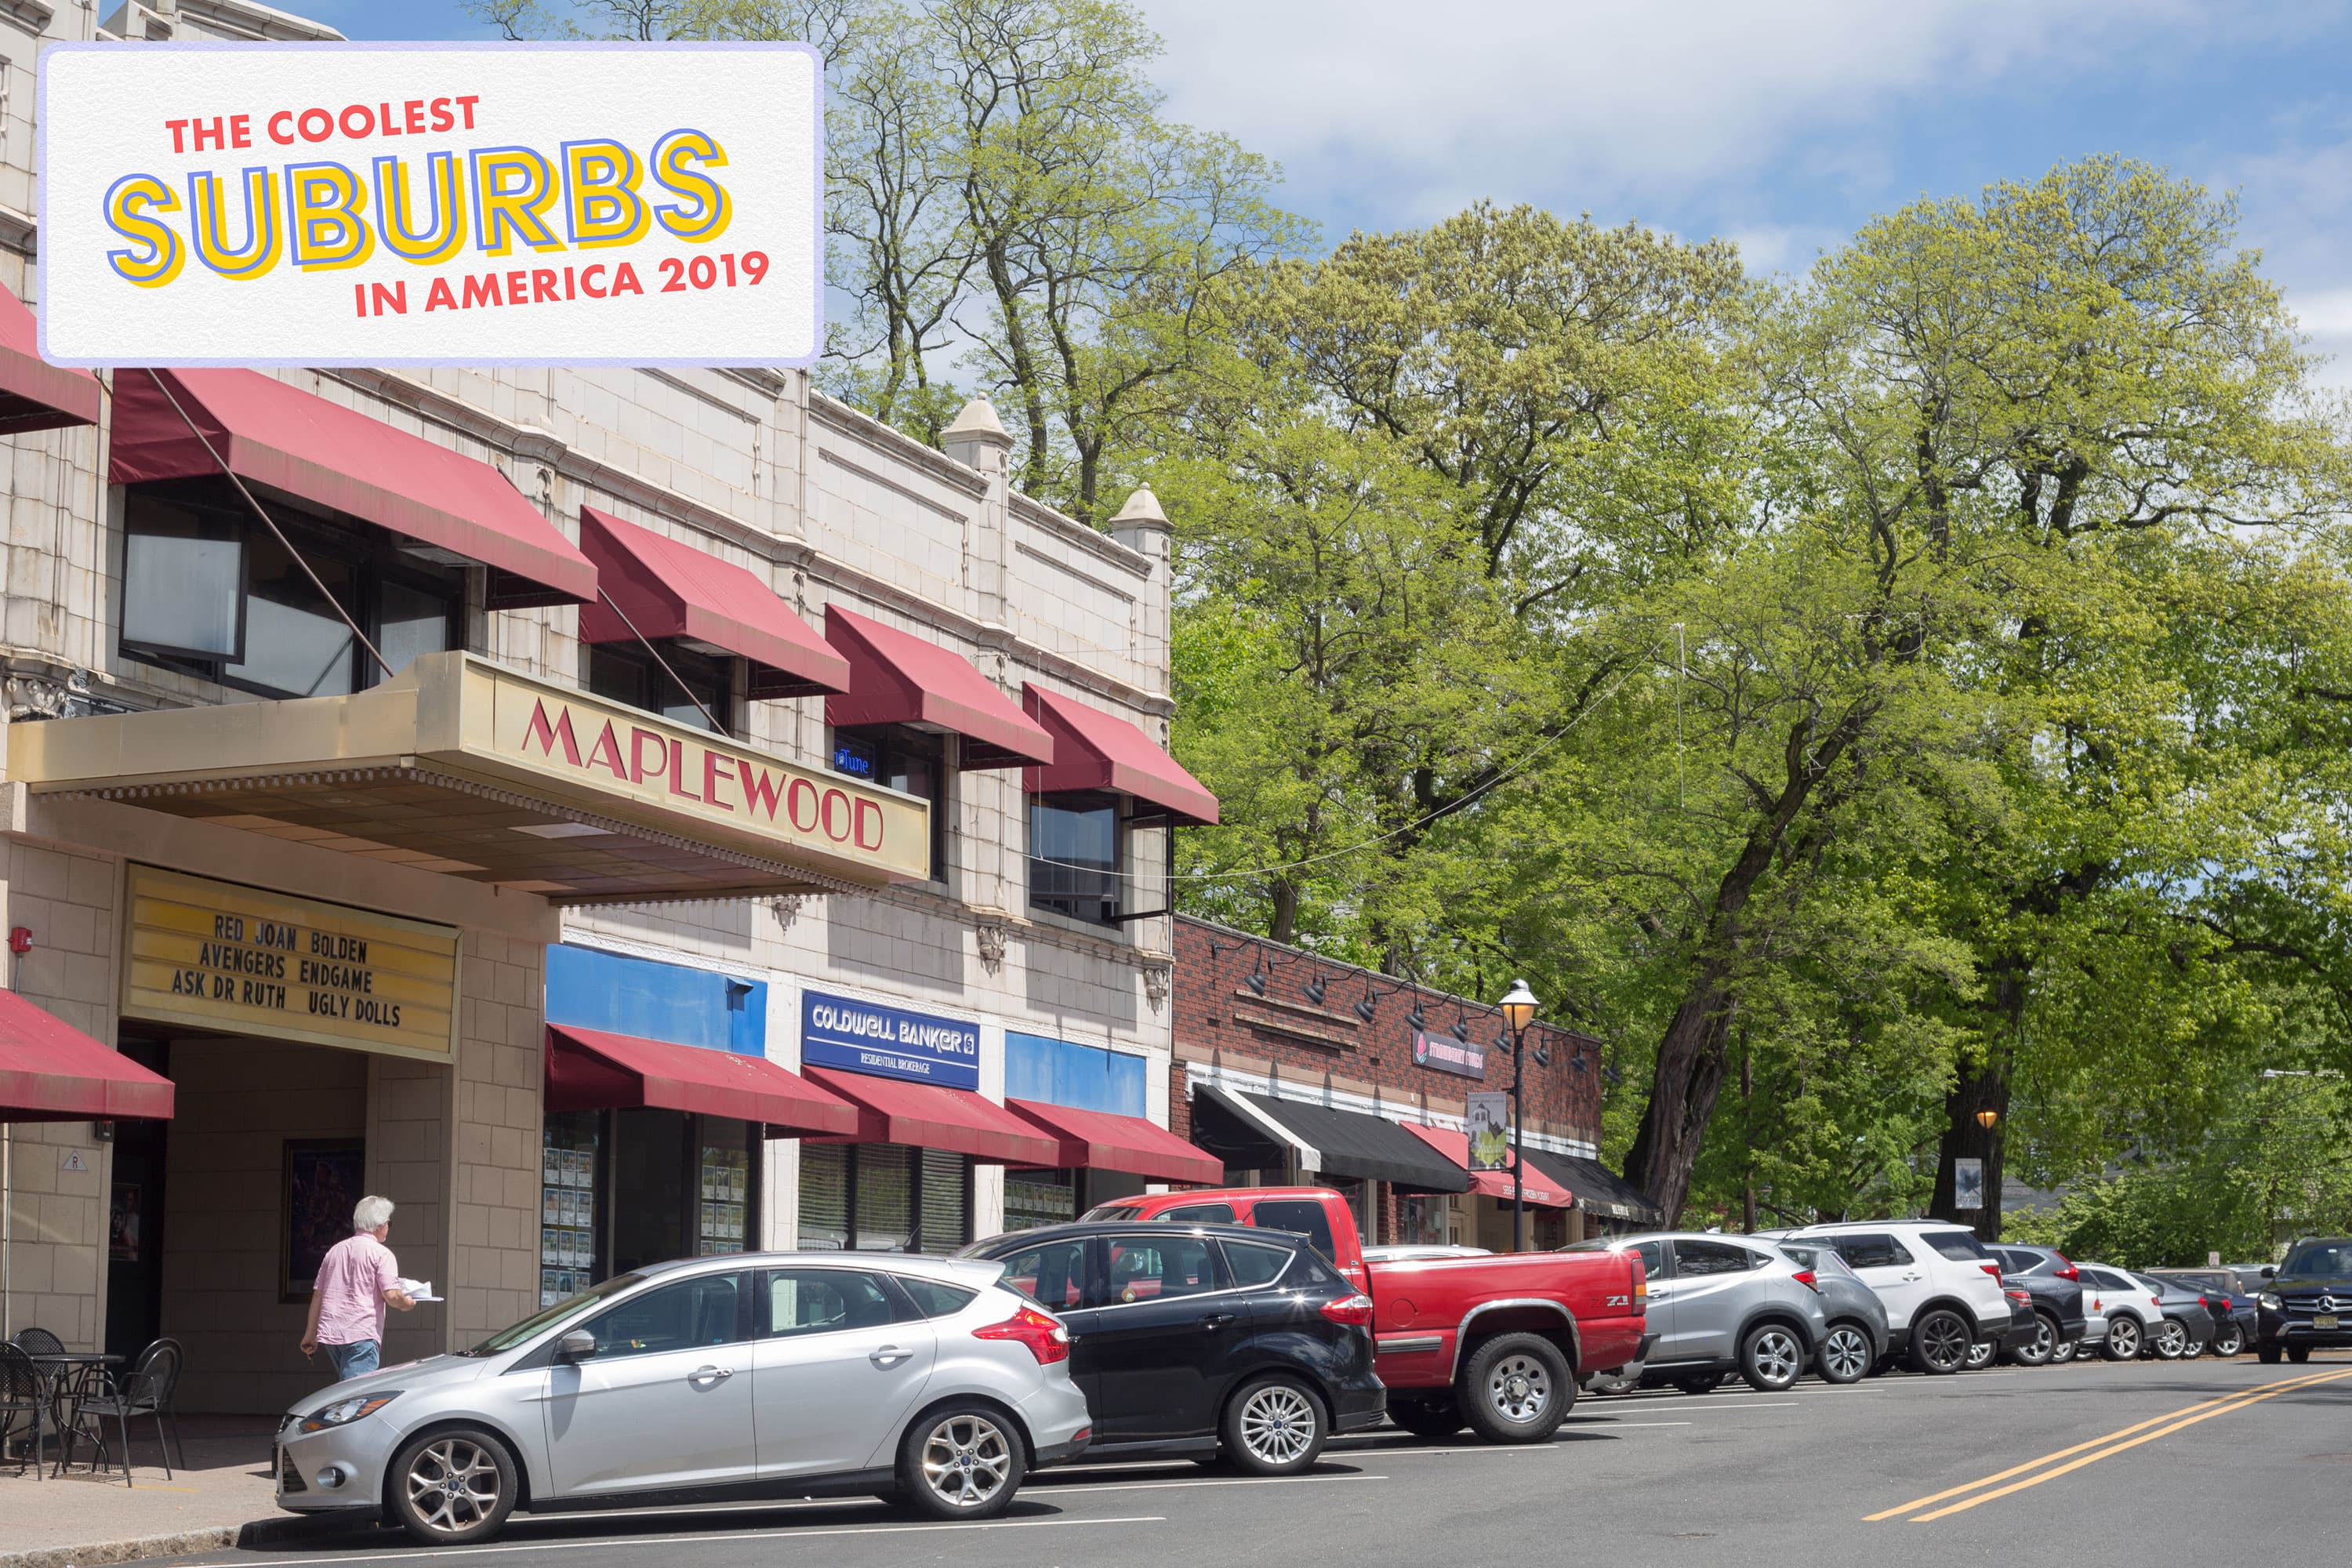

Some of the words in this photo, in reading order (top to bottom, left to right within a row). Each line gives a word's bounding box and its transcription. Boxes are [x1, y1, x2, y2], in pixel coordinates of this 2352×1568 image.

[521, 697, 884, 852] MAPLEWOOD
[215, 915, 243, 942] RED
[256, 922, 296, 951] JOAN
[311, 931, 366, 964] BOLDEN
[200, 942, 285, 979] AVENGERS
[300, 960, 372, 993] ENDGAME
[172, 969, 205, 996] ASK
[214, 975, 234, 1001] DR
[243, 981, 285, 1009] RUTH
[309, 991, 350, 1018] UGLY
[356, 999, 400, 1027] DOLLS
[813, 1004, 896, 1040] COLDWELL
[899, 1021, 962, 1053] BANKER
[861, 1052, 898, 1069] RESIDENTIAL
[898, 1058, 931, 1074] BROKERAGE
